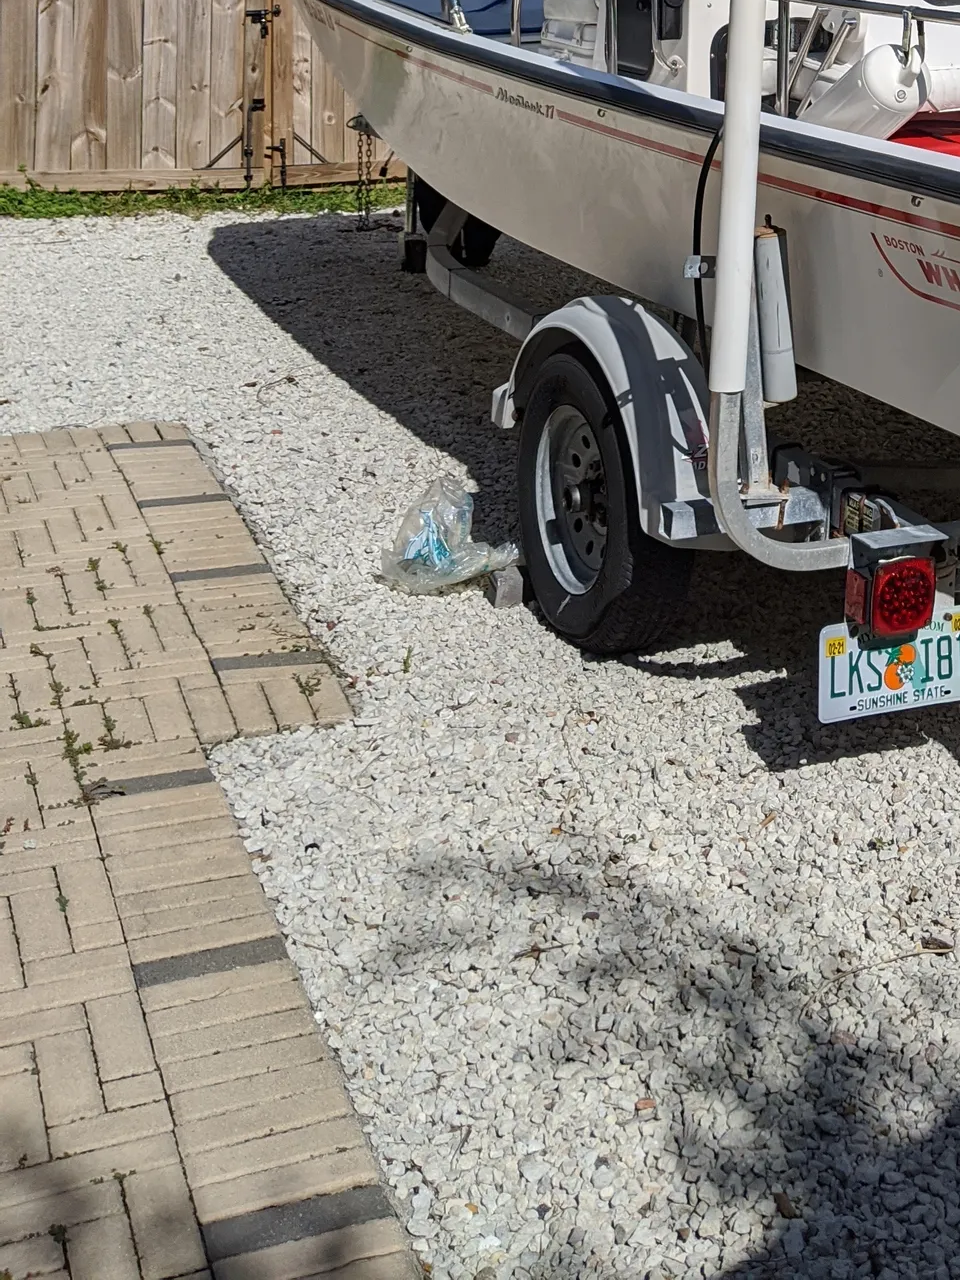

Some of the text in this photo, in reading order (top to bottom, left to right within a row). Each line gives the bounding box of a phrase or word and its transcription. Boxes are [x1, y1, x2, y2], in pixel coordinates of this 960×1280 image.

[883, 235, 925, 257] BOSTON
[857, 685, 946, 712] SUNSHINE STATE
